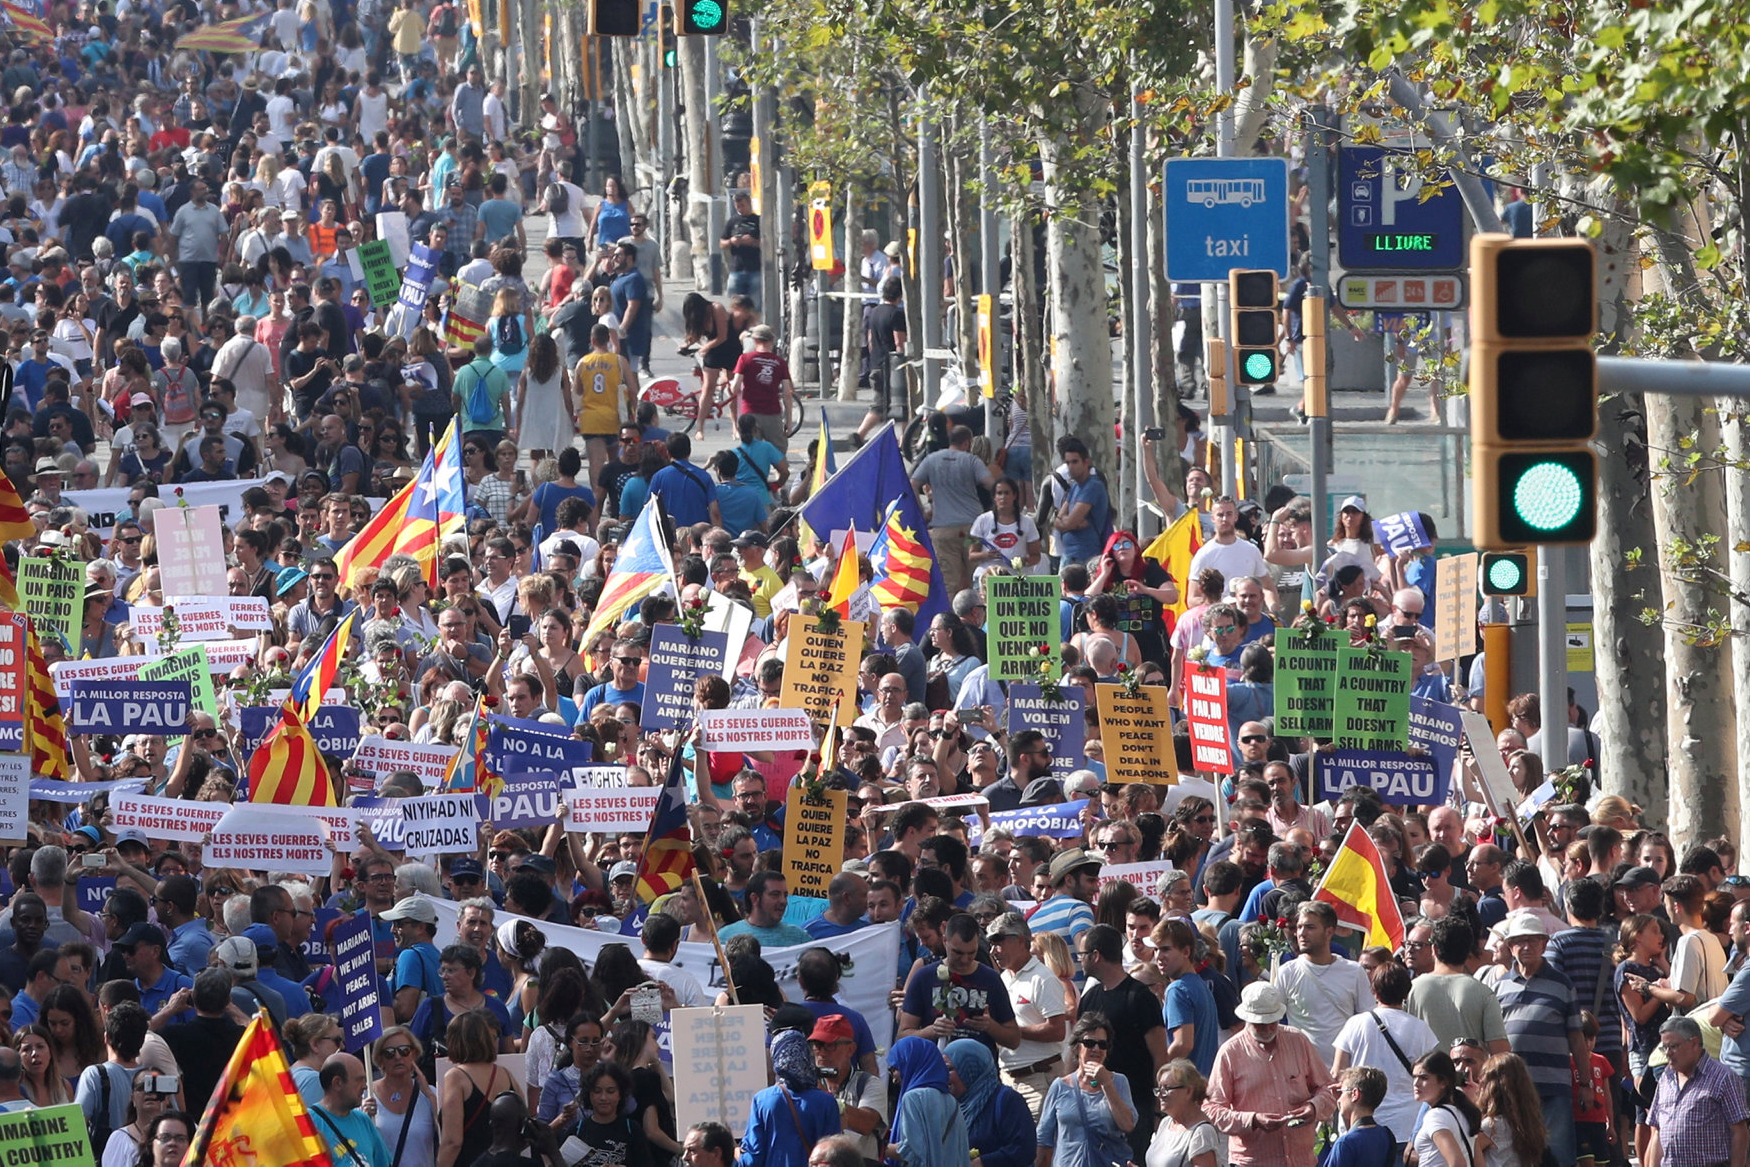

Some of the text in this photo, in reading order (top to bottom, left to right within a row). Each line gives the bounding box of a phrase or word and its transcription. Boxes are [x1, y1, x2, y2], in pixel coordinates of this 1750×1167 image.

[1381, 155, 1424, 225] P
[1205, 235, 1250, 257] taxi
[1375, 235, 1432, 251] LLIURE
[404, 284, 424, 305] PAU
[594, 373, 604, 393] 8
[1379, 514, 1414, 555] PAU
[994, 582, 1054, 597] IMAGINA
[996, 599, 1050, 617] UN PAÍS
[1000, 621, 1048, 638] QUE NO
[806, 637, 844, 649] QUIEN
[801, 648, 846, 661] QUIERE
[800, 660, 844, 673] LA PAZ
[811, 673, 830, 683] NO
[1340, 676, 1406, 694] A COUNTRY
[74, 690, 186, 701] LA MILLOR RESPOSTA
[793, 683, 845, 697] TRAFICA
[804, 697, 830, 707] CON
[1356, 697, 1388, 713] THAT
[73, 702, 186, 727] LA PAU
[708, 719, 724, 729] LES
[726, 717, 758, 729] SEVES
[1346, 717, 1396, 734] DOESN'T
[706, 729, 810, 743] ELS NOSTRES MORTS
[1338, 736, 1402, 752] SELL ARMS
[10, 763, 22, 771] LES
[1322, 757, 1434, 771] LA MILLOR RESPOSTA
[1323, 768, 1434, 798] LA PAU
[402, 799, 472, 821] NI YIHAD NI
[213, 833, 322, 847] LES SEVES GUERRES,
[406, 827, 472, 850] CRUZADAS.
[212, 847, 323, 860] ELS NOSTRES MORTS
[337, 929, 370, 956] MARIANO,
[340, 950, 372, 977] WE WANT
[346, 974, 370, 995] PEACE,
[342, 991, 378, 1019] NOT ARMS
[352, 1016, 374, 1037] SALES
[6, 1139, 84, 1167] COUNTRY
